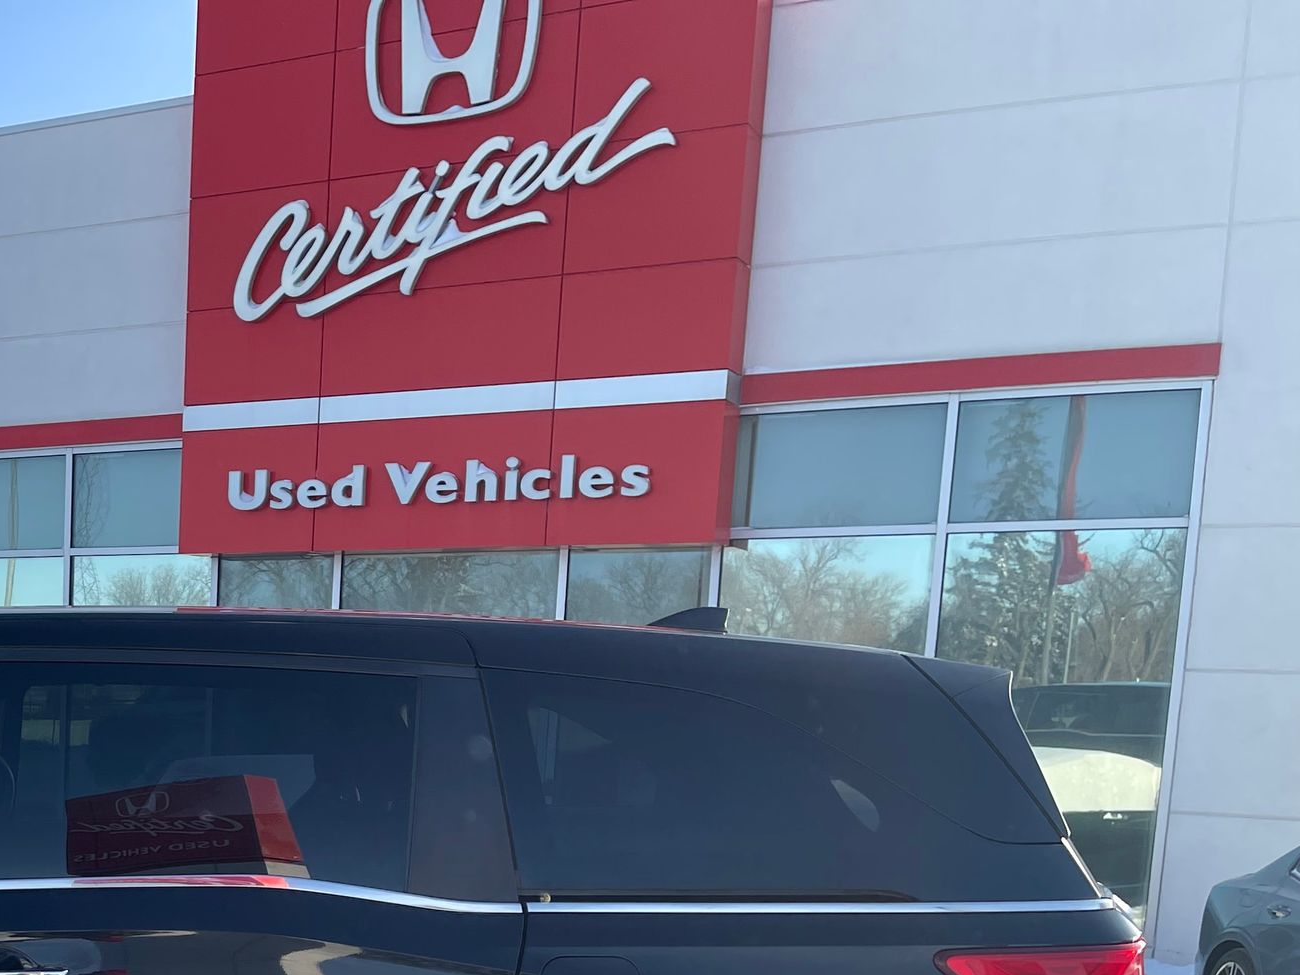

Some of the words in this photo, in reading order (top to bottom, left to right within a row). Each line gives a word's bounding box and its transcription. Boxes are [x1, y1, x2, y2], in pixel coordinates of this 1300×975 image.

[233, 77, 677, 323] Certified
[227, 464, 367, 511] Used
[385, 455, 652, 505] Vehicles
